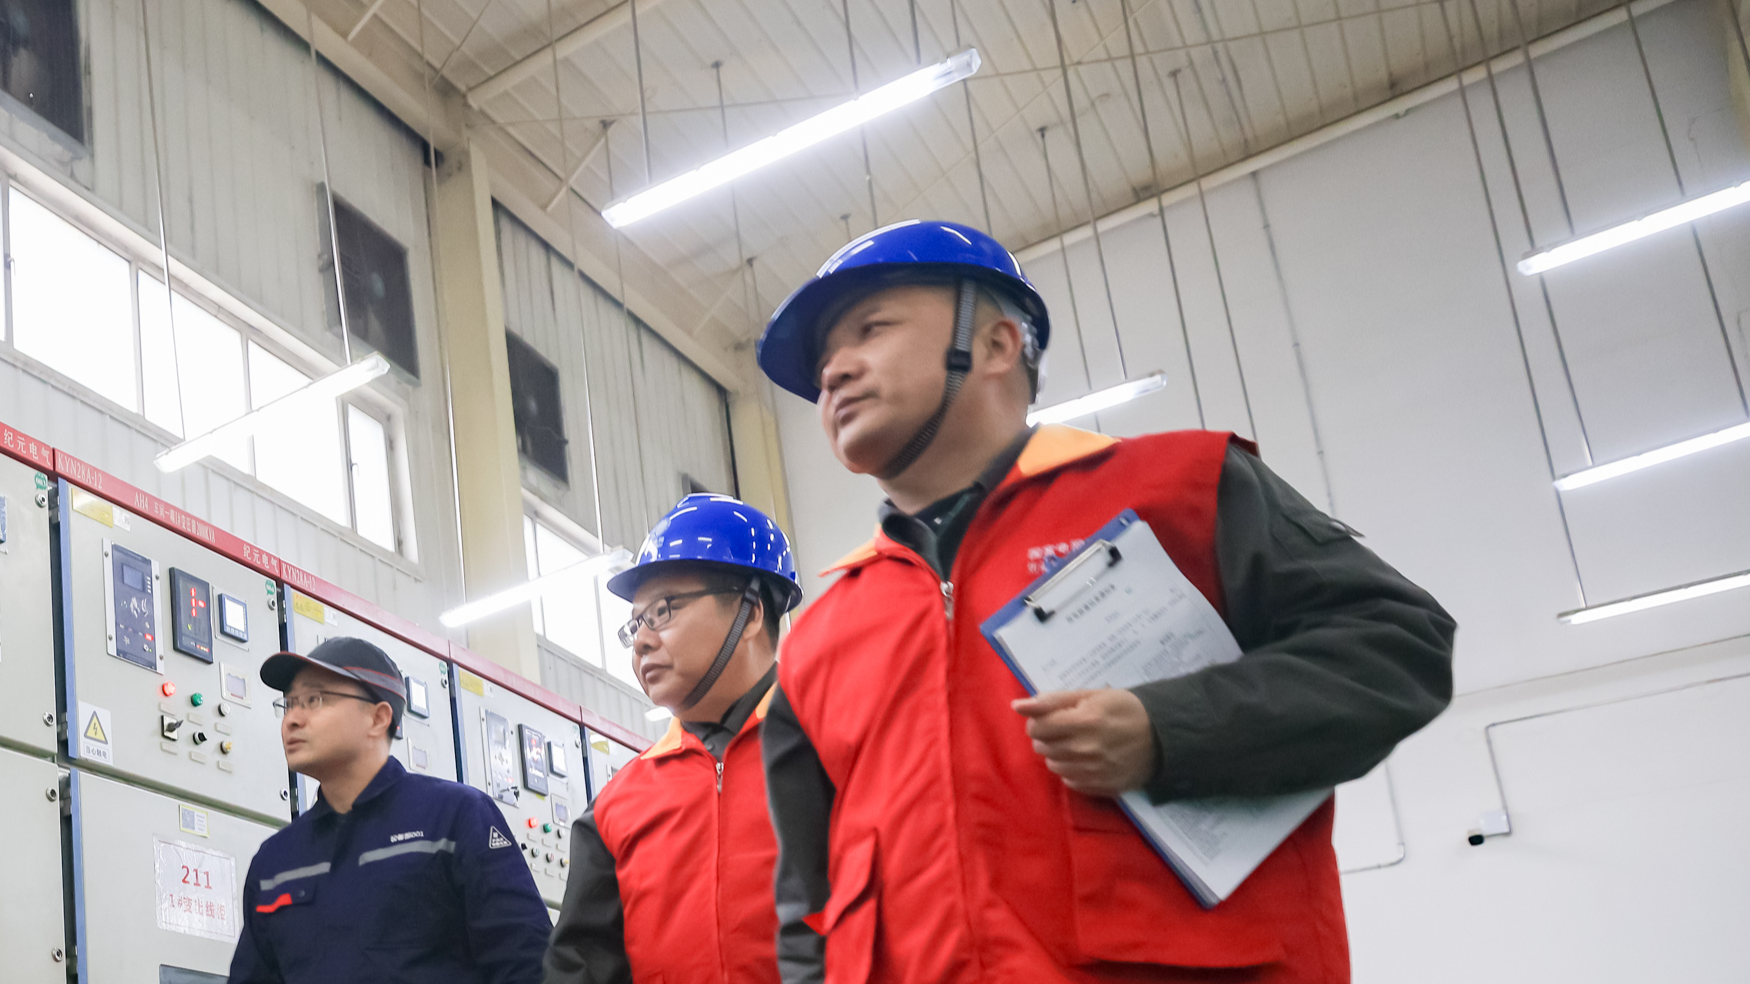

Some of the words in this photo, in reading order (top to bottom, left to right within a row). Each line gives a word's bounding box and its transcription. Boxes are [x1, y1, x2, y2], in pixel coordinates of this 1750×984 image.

[3, 428, 51, 466] 纪元电气
[58, 452, 102, 490] KYN28A-12
[134, 491, 149, 511] AH4
[181, 865, 212, 889] 211
